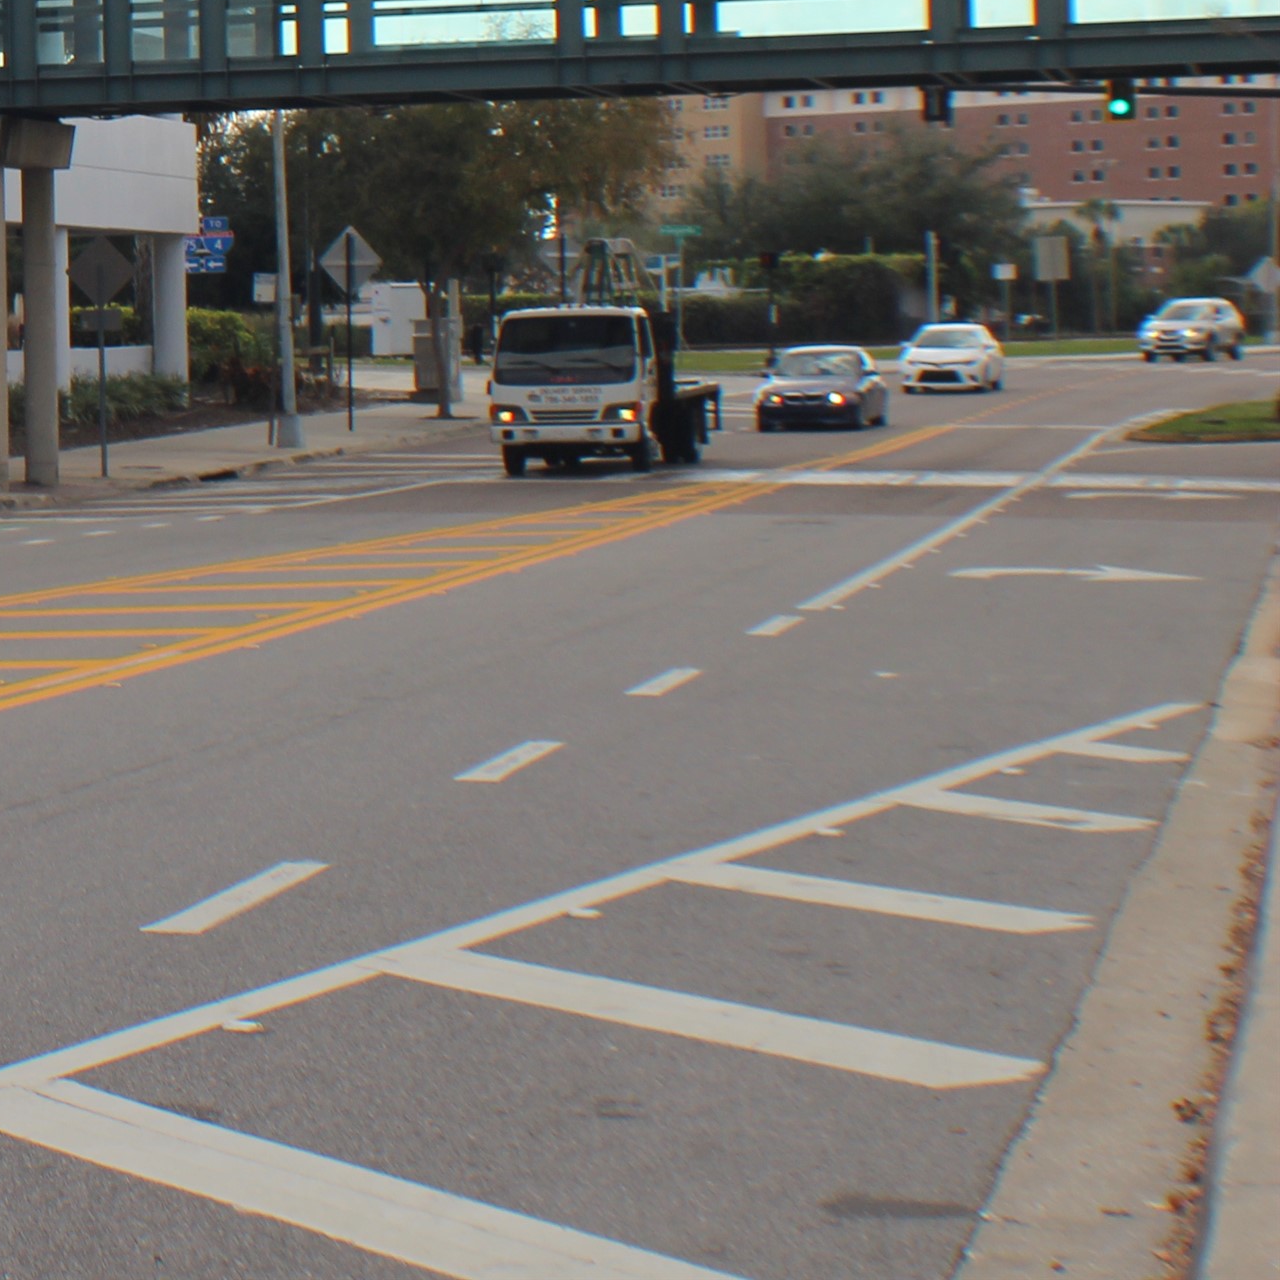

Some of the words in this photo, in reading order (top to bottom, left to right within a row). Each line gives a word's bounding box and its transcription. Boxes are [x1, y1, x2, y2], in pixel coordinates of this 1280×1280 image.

[209, 220, 222, 228] TO
[185, 239, 197, 251] 75
[214, 239, 223, 250] 4
